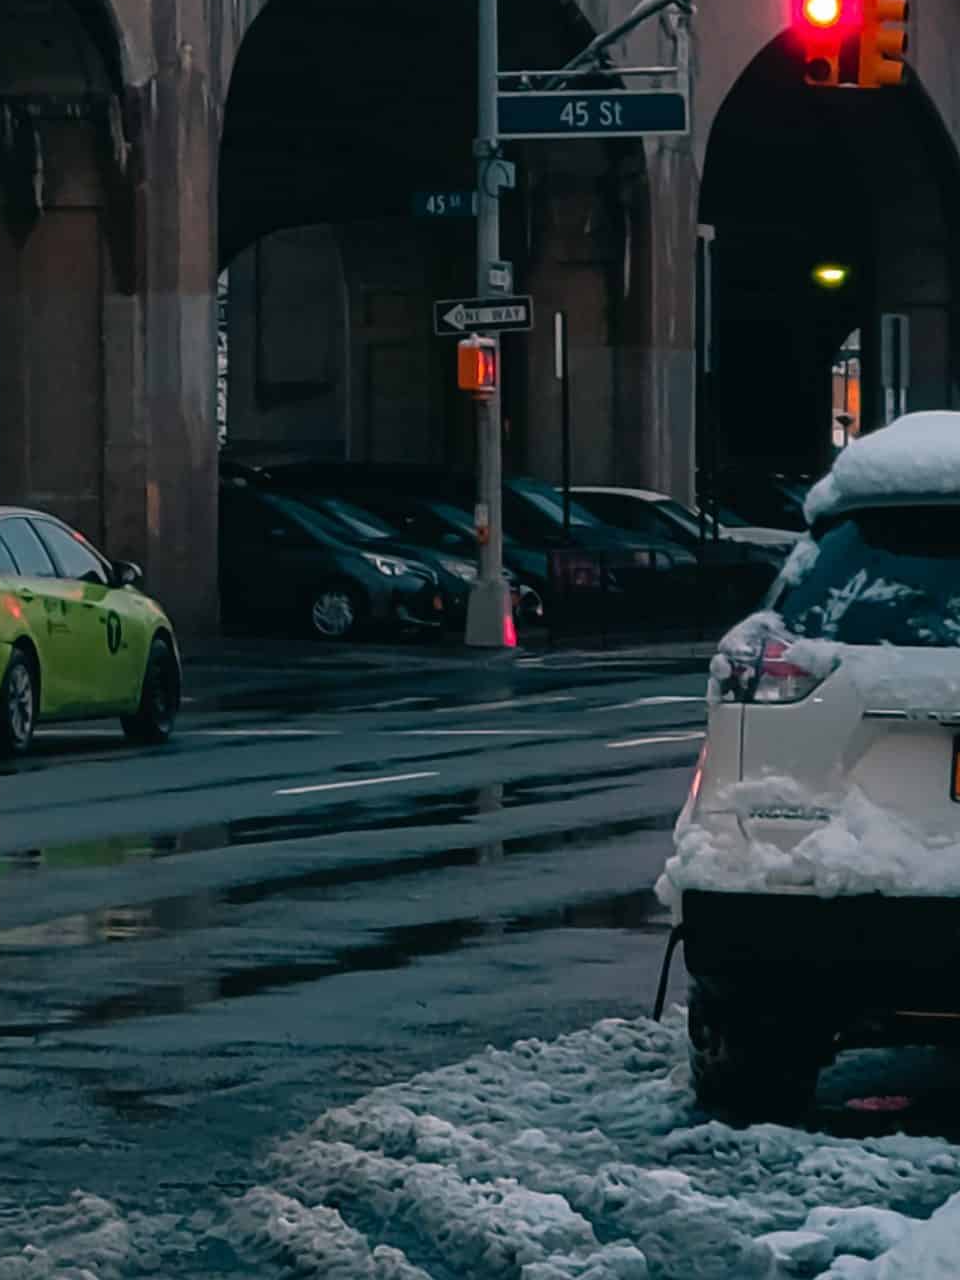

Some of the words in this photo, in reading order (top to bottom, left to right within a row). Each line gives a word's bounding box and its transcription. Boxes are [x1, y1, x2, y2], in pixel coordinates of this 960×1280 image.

[559, 101, 589, 127] 45
[599, 100, 623, 127] St
[425, 194, 446, 215] 45
[455, 311, 480, 323] ONE
